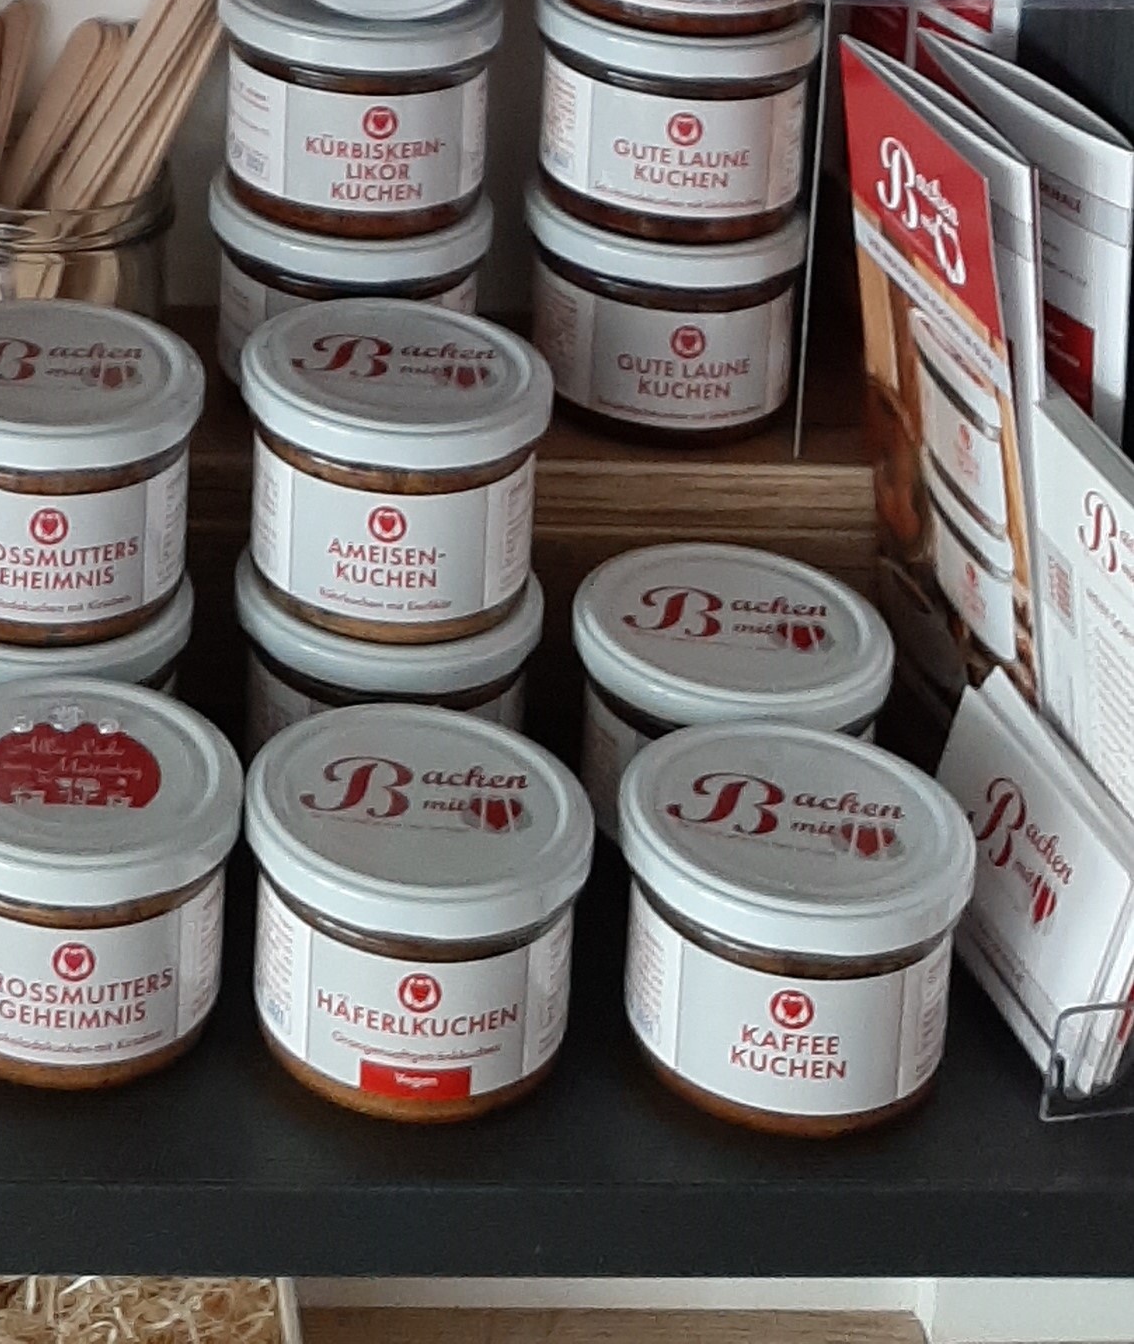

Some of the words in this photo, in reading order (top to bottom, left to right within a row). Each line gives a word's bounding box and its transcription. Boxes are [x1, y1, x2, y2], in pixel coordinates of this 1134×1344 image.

[303, 135, 448, 164] KÜRBISKERN-
[613, 138, 672, 163] GUTE
[678, 147, 751, 168] LAUNE
[330, 180, 424, 203] KUCHEN
[633, 165, 728, 189] KUCHEN
[291, 333, 497, 379] Backen
[617, 354, 674, 376] GUTE
[683, 357, 751, 376] LAUNE
[637, 375, 733, 400] KUCHEN
[327, 538, 446, 566] AMEISEN-
[334, 562, 438, 589] KUCHEN
[623, 585, 828, 638] Backen
[298, 755, 529, 819] Backen
[667, 772, 906, 835] Backen
[976, 776, 1072, 886] Backen
[316, 988, 520, 1038] HÄFERLKUCHEN
[741, 1023, 841, 1056] KAFFEE
[730, 1046, 848, 1080] KUCHEN
